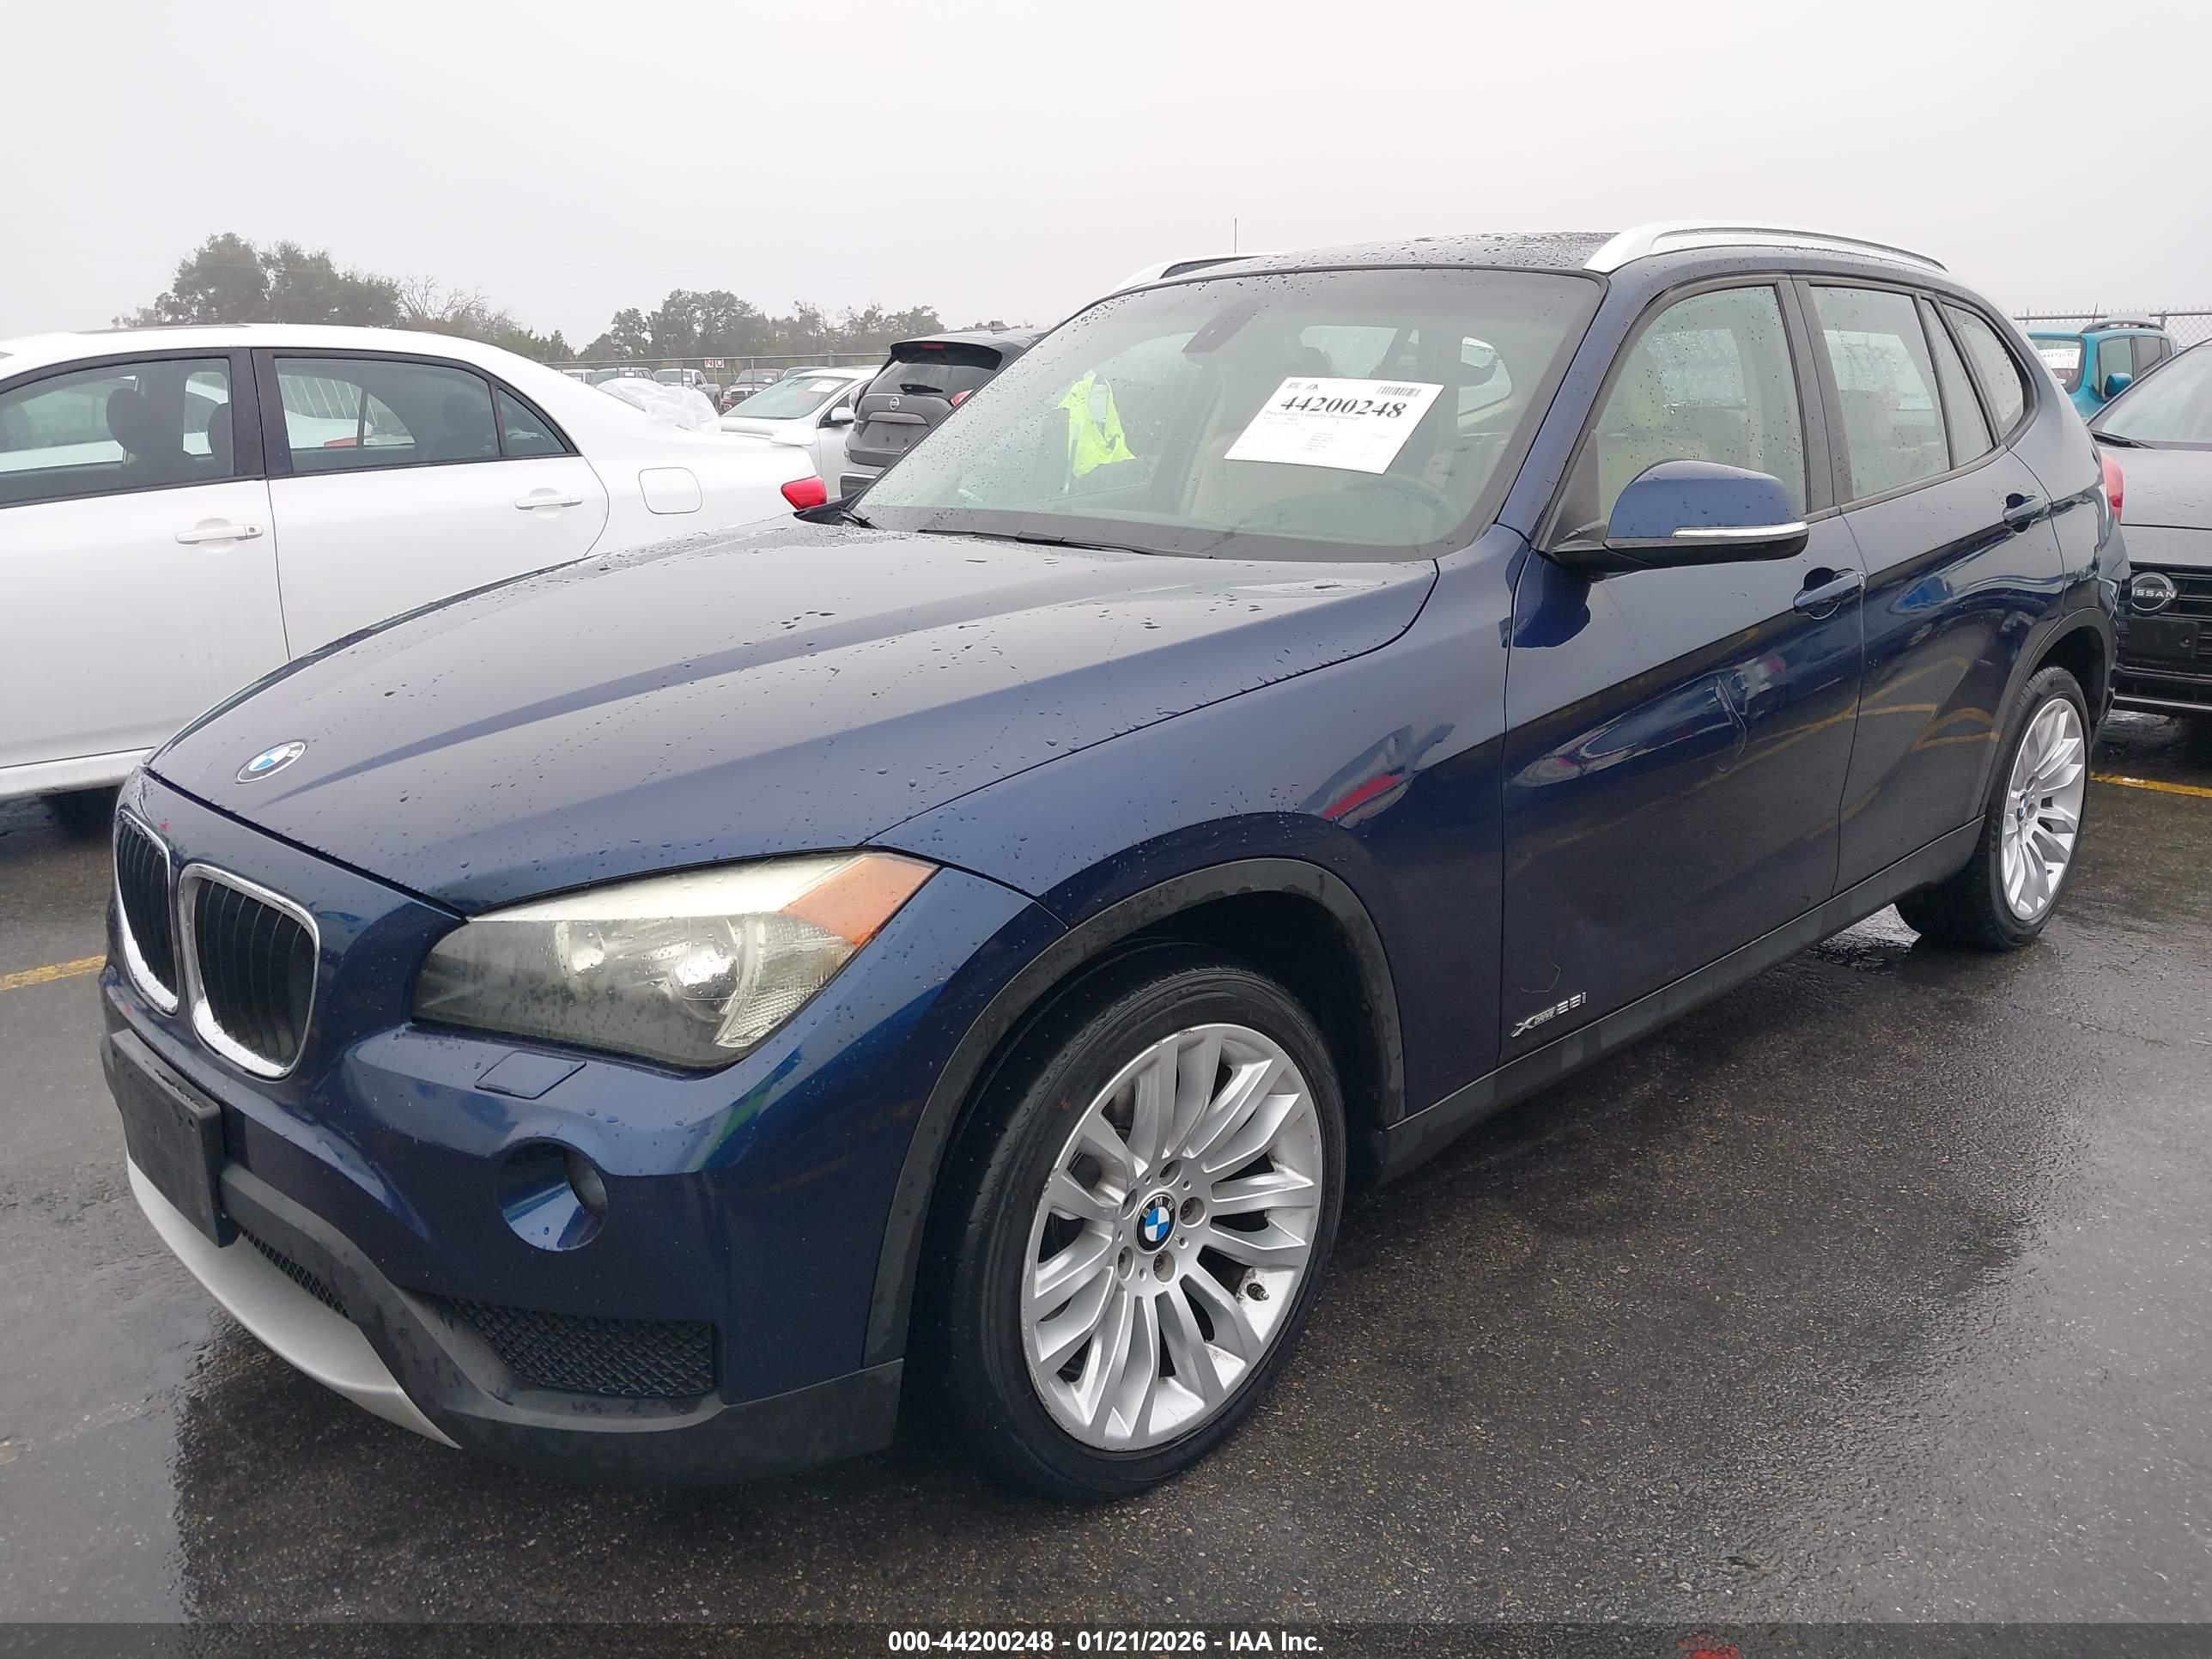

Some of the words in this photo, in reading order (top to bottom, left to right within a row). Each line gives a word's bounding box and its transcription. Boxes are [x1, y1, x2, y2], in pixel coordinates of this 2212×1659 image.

[1280, 396, 1407, 419] 44200248
[2132, 589, 2175, 599] ISSAN
[1142, 1197, 1175, 1218] BMW
